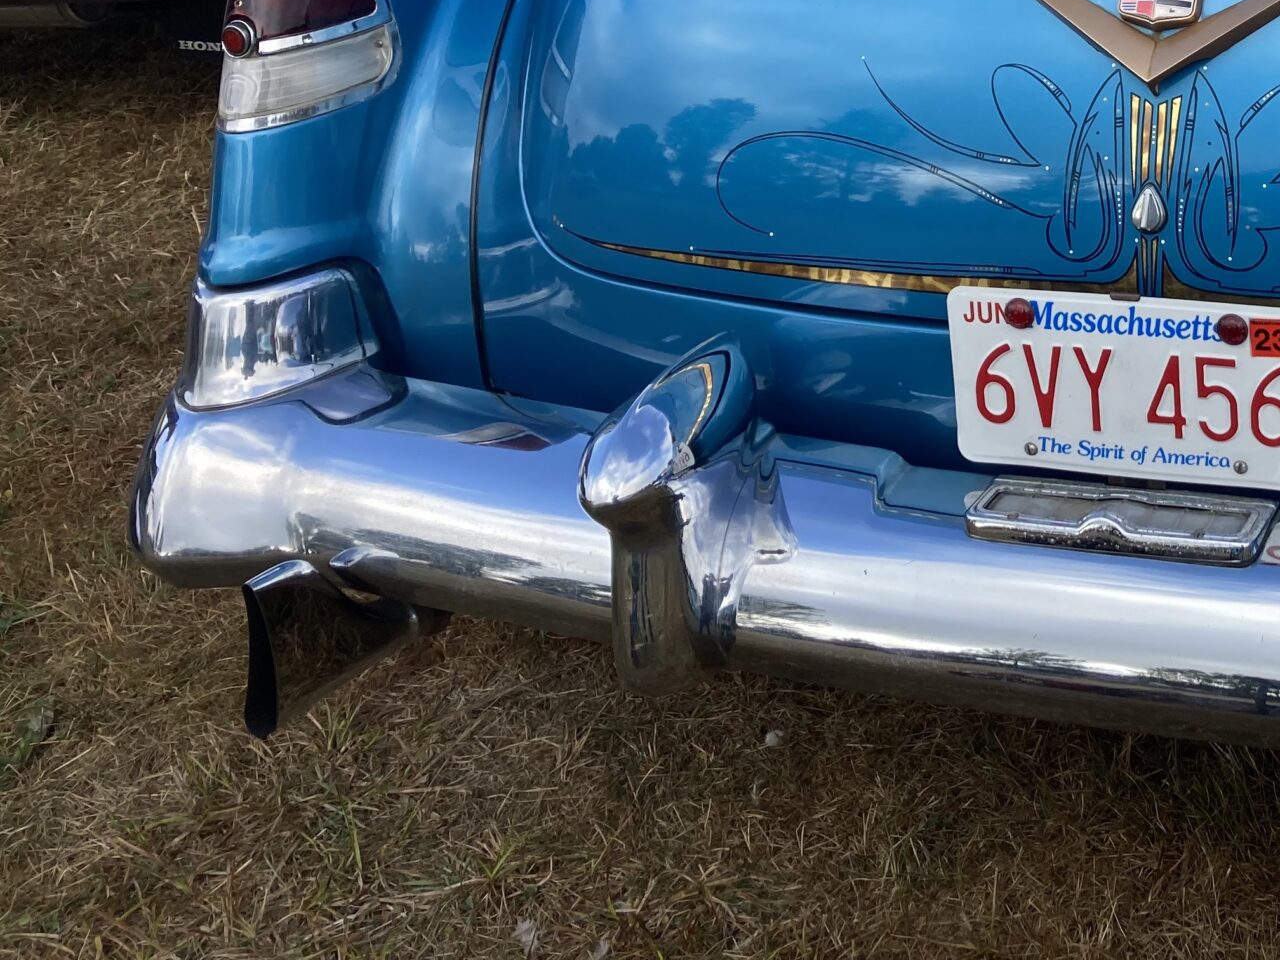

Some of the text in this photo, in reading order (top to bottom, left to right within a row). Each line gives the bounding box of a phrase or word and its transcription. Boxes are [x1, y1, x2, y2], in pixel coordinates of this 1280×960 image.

[178, 40, 224, 52] HON
[975, 343, 1112, 433] 6VY
[1037, 436, 1231, 468] The Spirit of America
